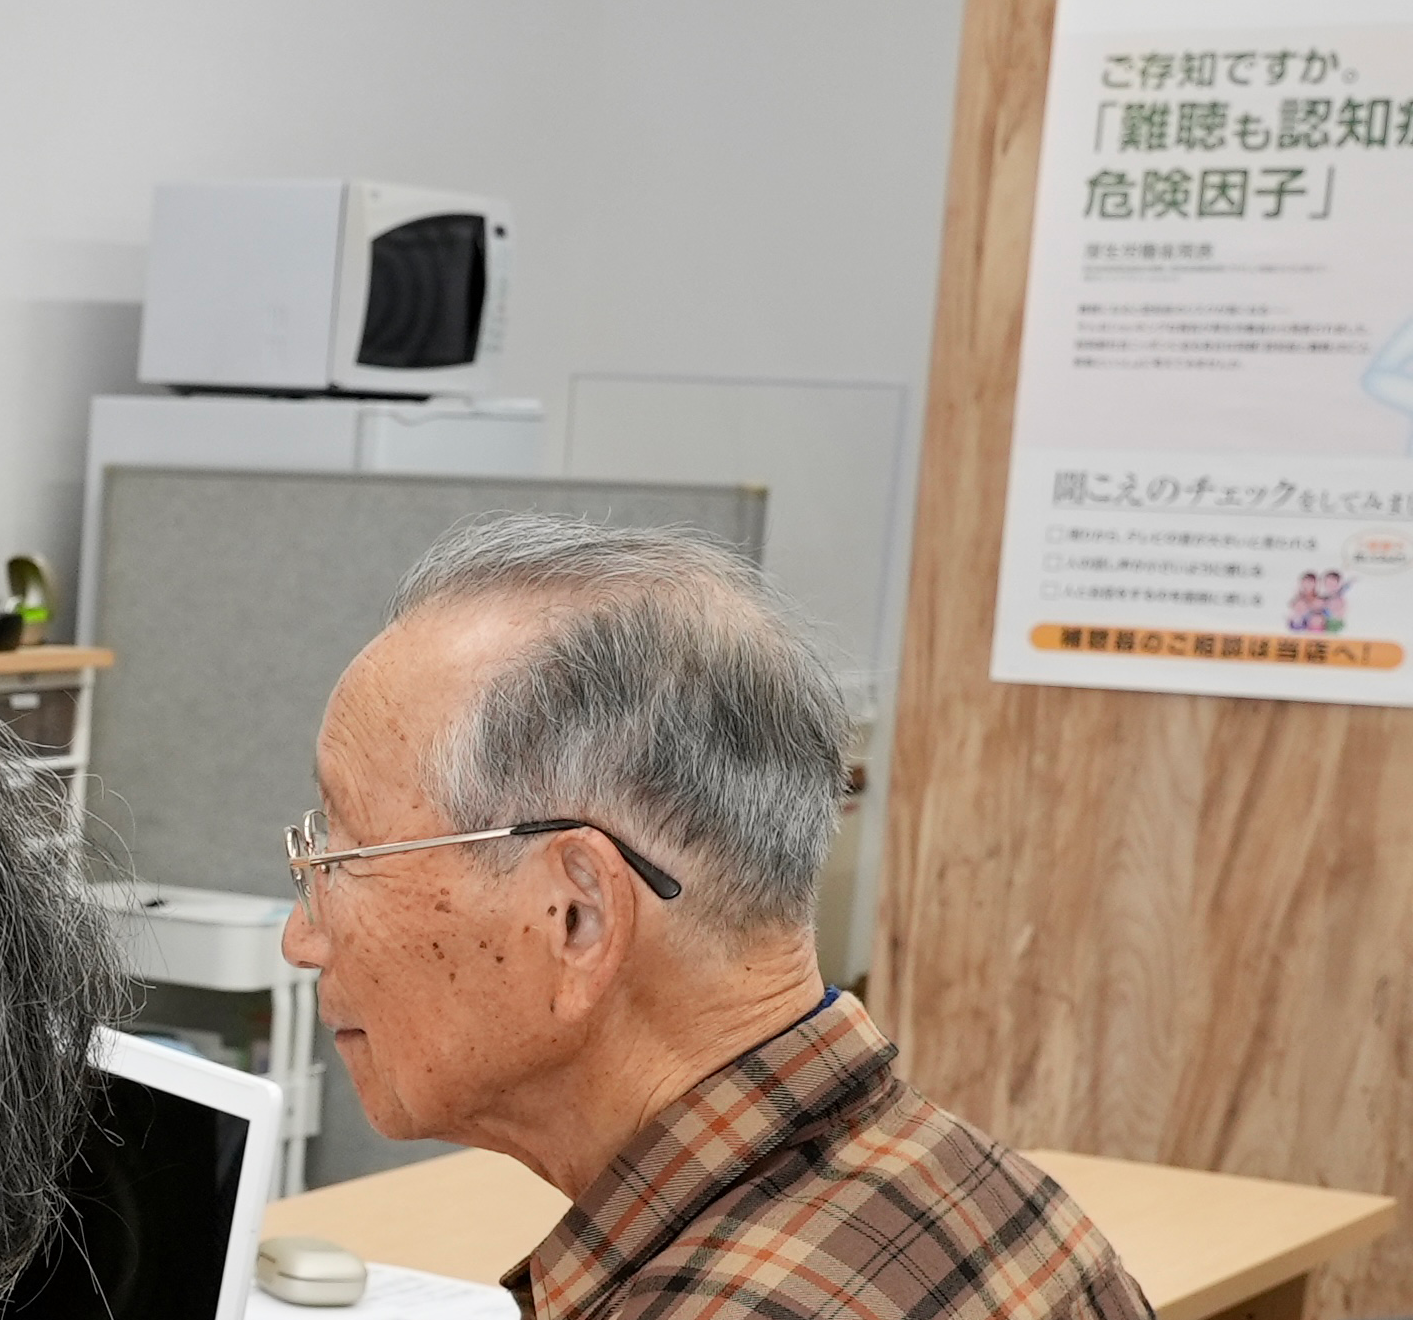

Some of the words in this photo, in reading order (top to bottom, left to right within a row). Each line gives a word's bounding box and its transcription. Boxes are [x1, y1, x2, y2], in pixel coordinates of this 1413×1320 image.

[1101, 49, 1359, 90] ご存知ですか。
[1093, 97, 1413, 152] 「難聴も認知
[1084, 166, 1337, 220] 危険因子」
